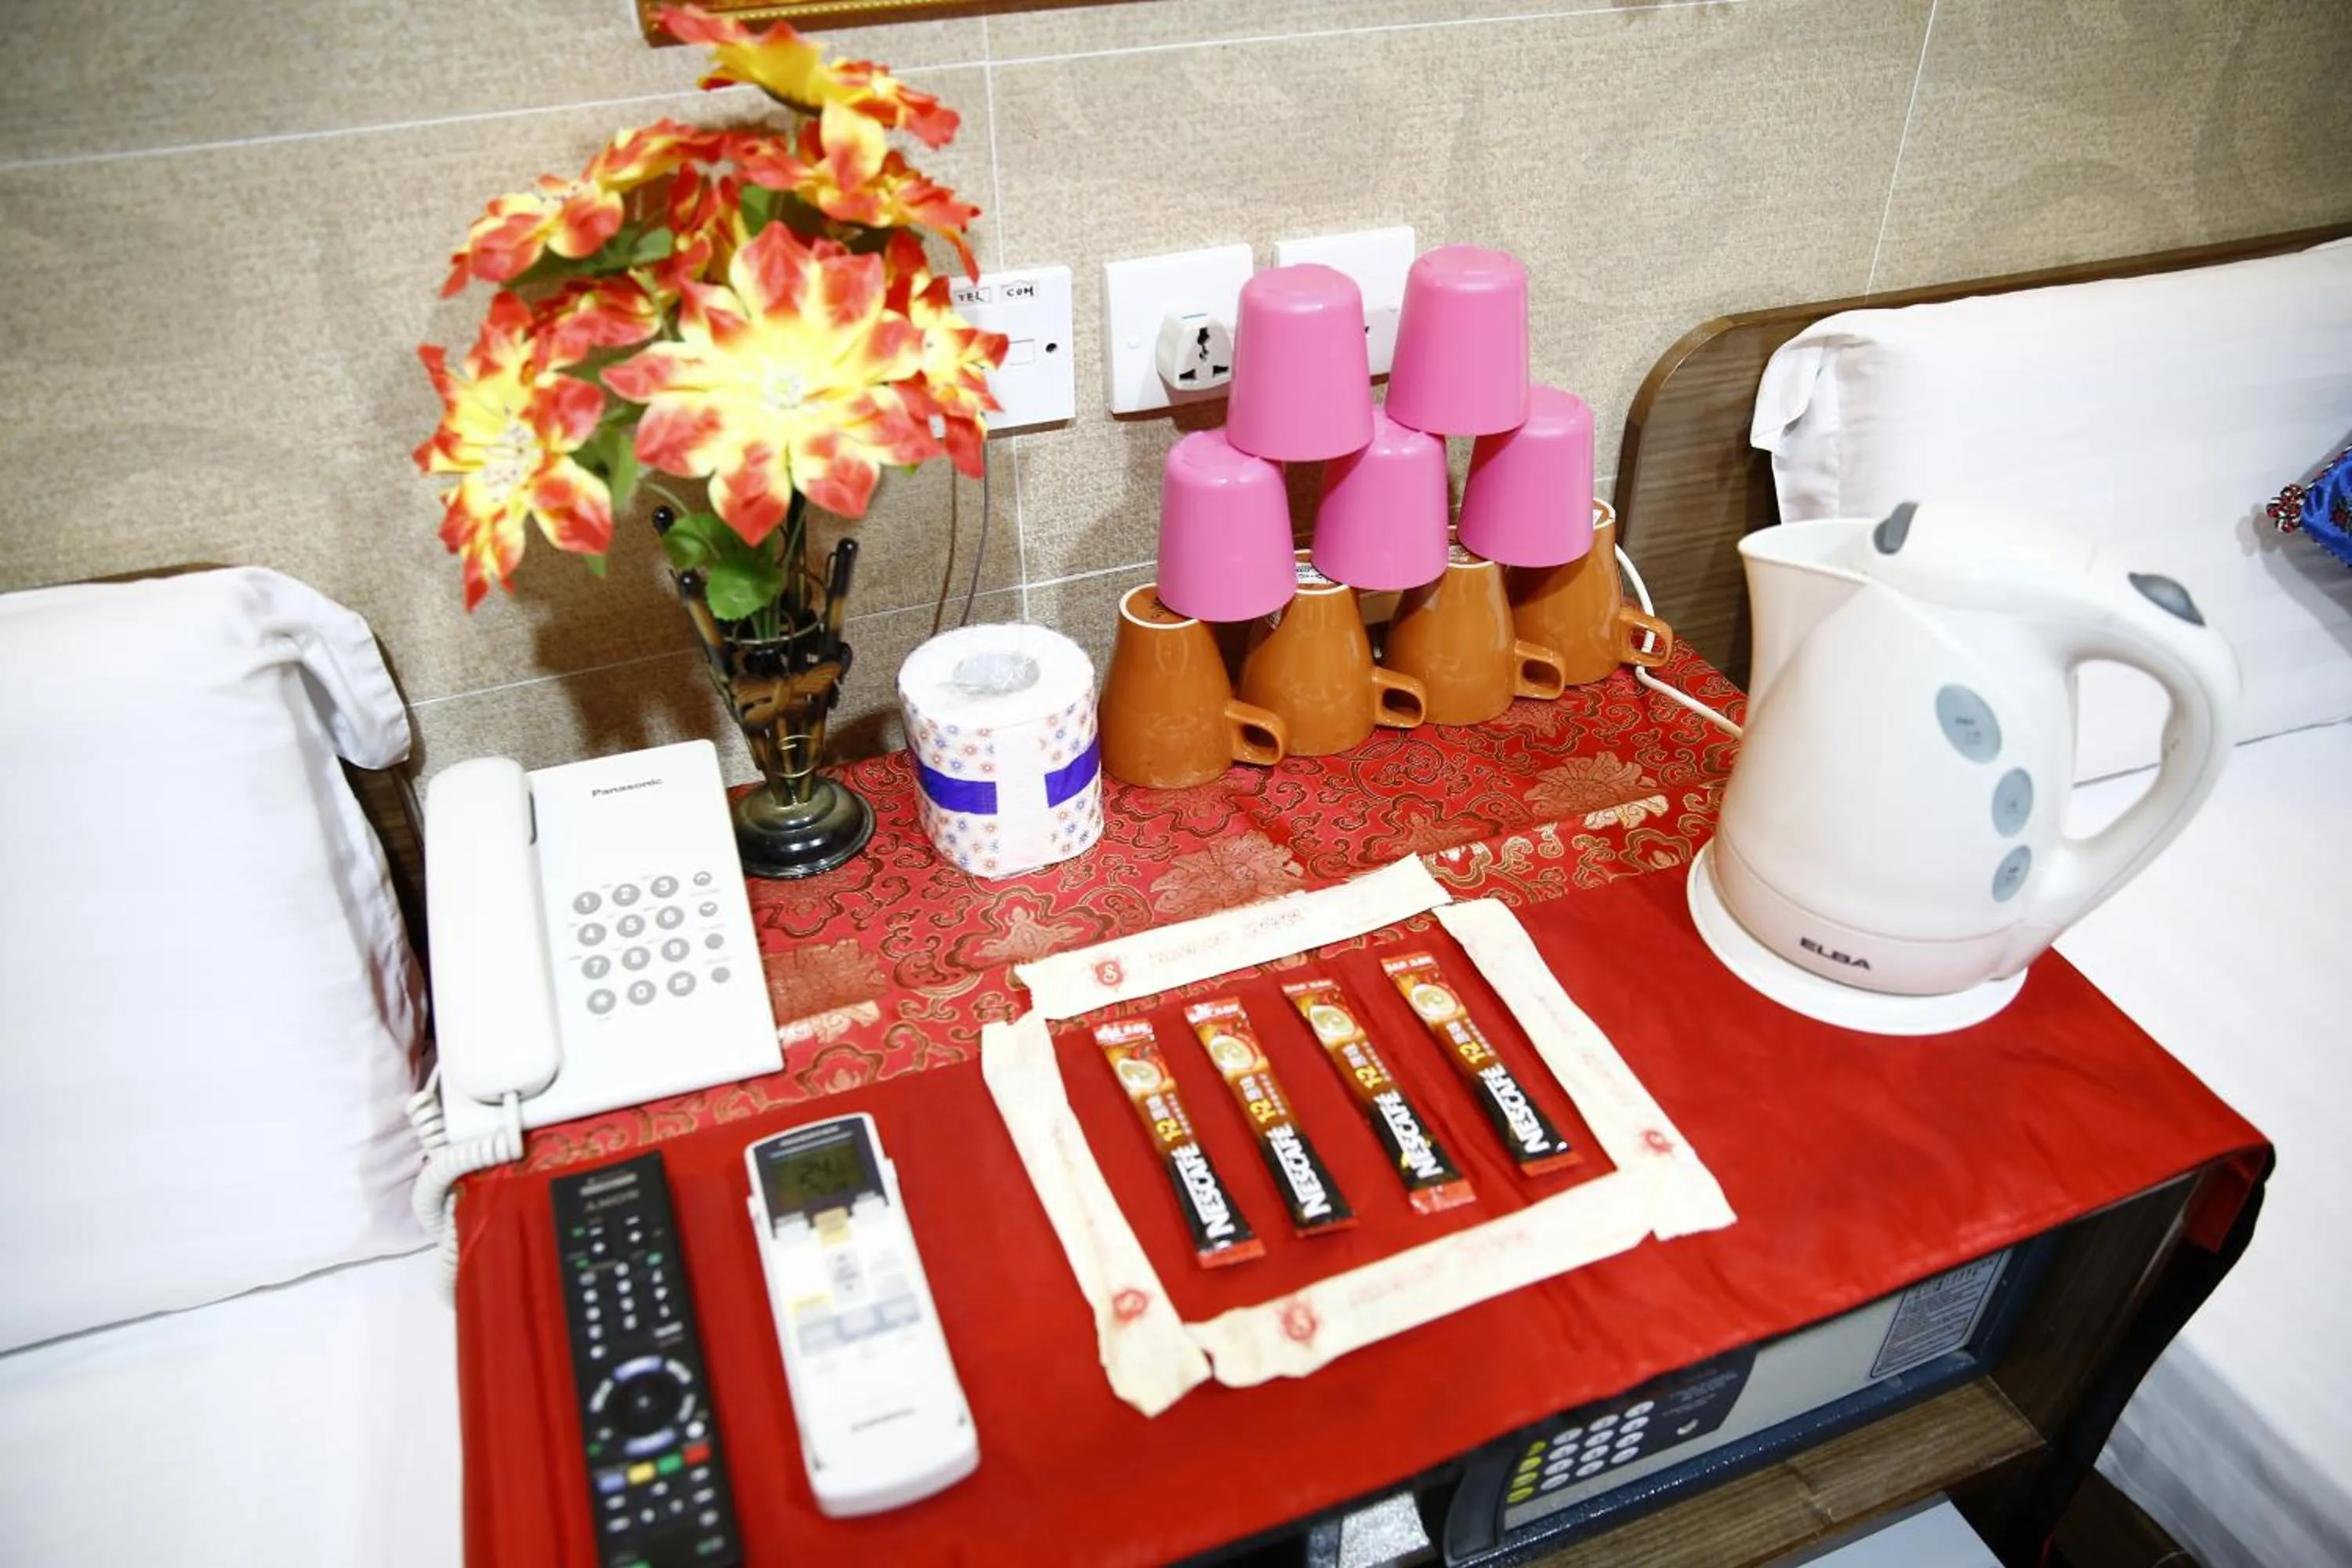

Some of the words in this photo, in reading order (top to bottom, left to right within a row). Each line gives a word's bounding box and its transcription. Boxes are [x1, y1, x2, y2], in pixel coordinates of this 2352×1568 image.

[958, 291, 984, 301] TEL
[1006, 286, 1034, 297] COM
[1800, 937, 1871, 971] ELBA
